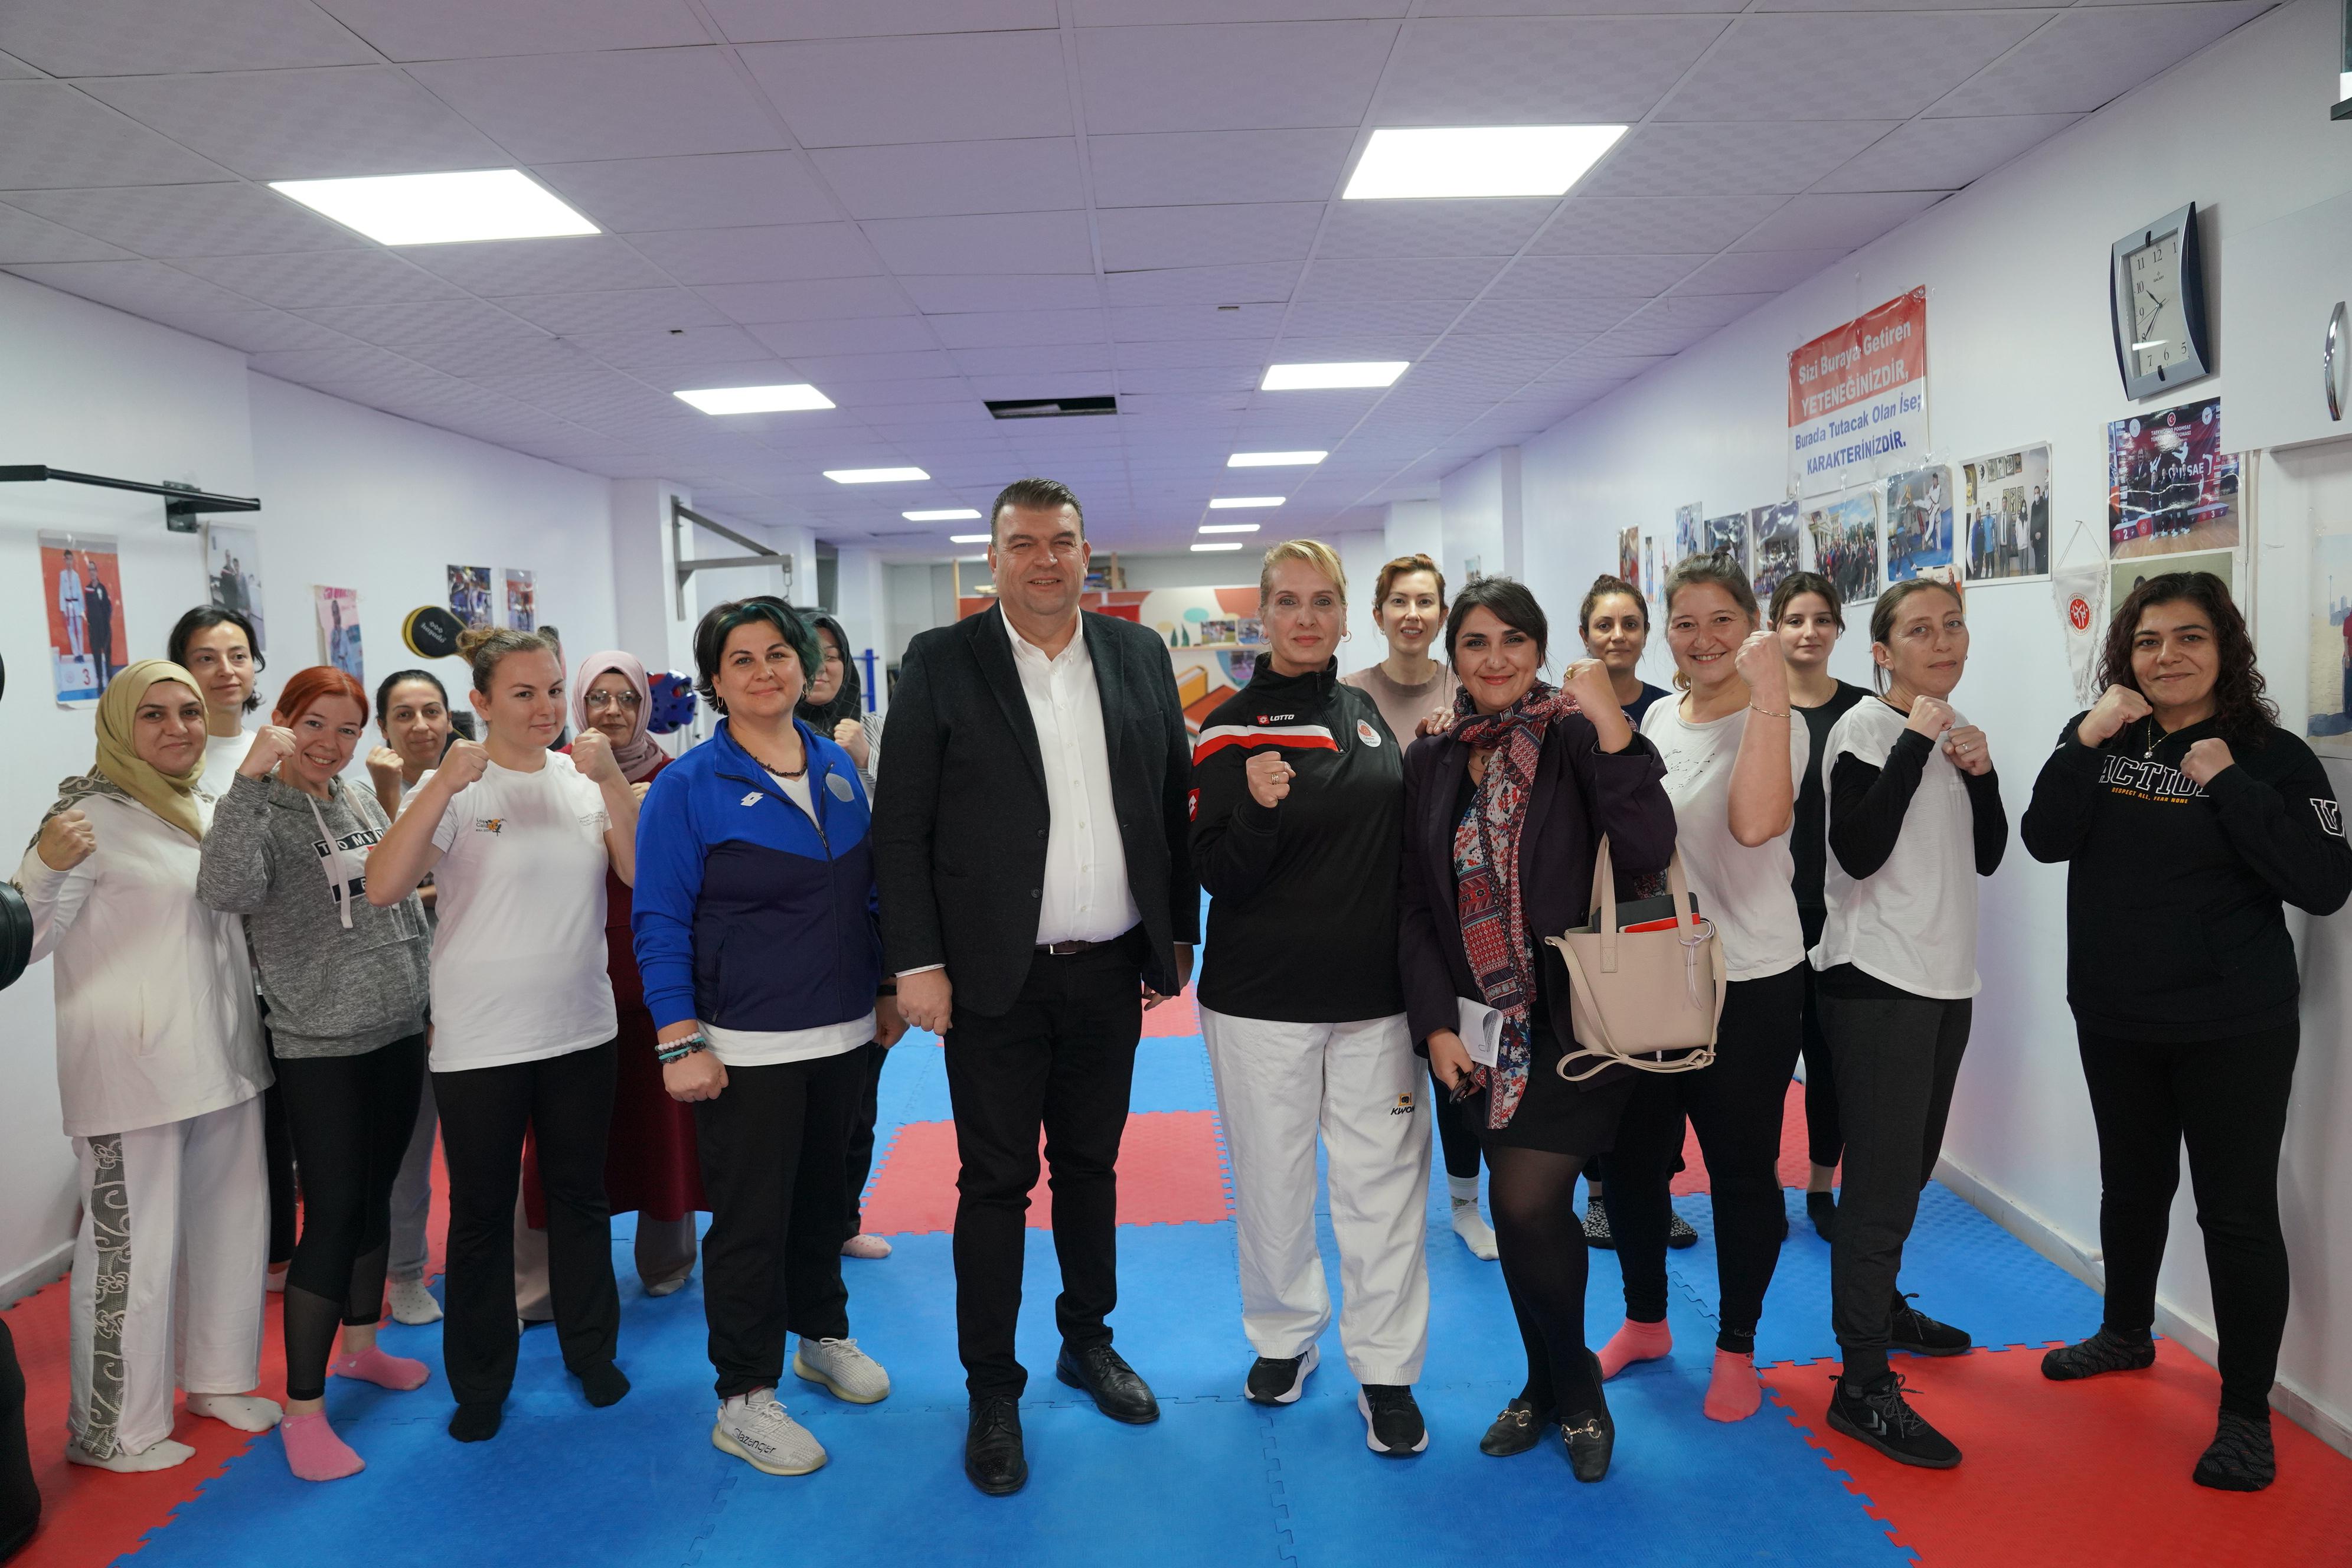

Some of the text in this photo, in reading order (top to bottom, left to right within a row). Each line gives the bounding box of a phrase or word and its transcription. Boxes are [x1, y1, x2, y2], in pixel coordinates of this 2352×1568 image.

[2137, 241, 2177, 270] 11 12 1
[2137, 280, 2144, 294] 10
[2139, 307, 2144, 319] 9
[1799, 321, 1911, 385] Sizi Buraya Getiren
[2147, 341, 2187, 367] 7 6 5
[1802, 357, 1909, 417] YETENEĞİNİZDİR,
[1795, 427, 1826, 450] Burada
[1829, 410, 1869, 439] Tutacak
[1872, 404, 1896, 423] Olan
[1807, 429, 1906, 475] KARAKTERİNİZDİR.
[2211, 510, 2215, 518] 3
[2123, 528, 2128, 540] 2
[83, 668, 90, 685] 3
[2099, 755, 2209, 798] ACTIO
[2112, 787, 2137, 796] RESPECT
[2138, 792, 2151, 801] ALL,
[1390, 1105, 1416, 1115] KWON
[732, 1427, 776, 1453] Slazenger
